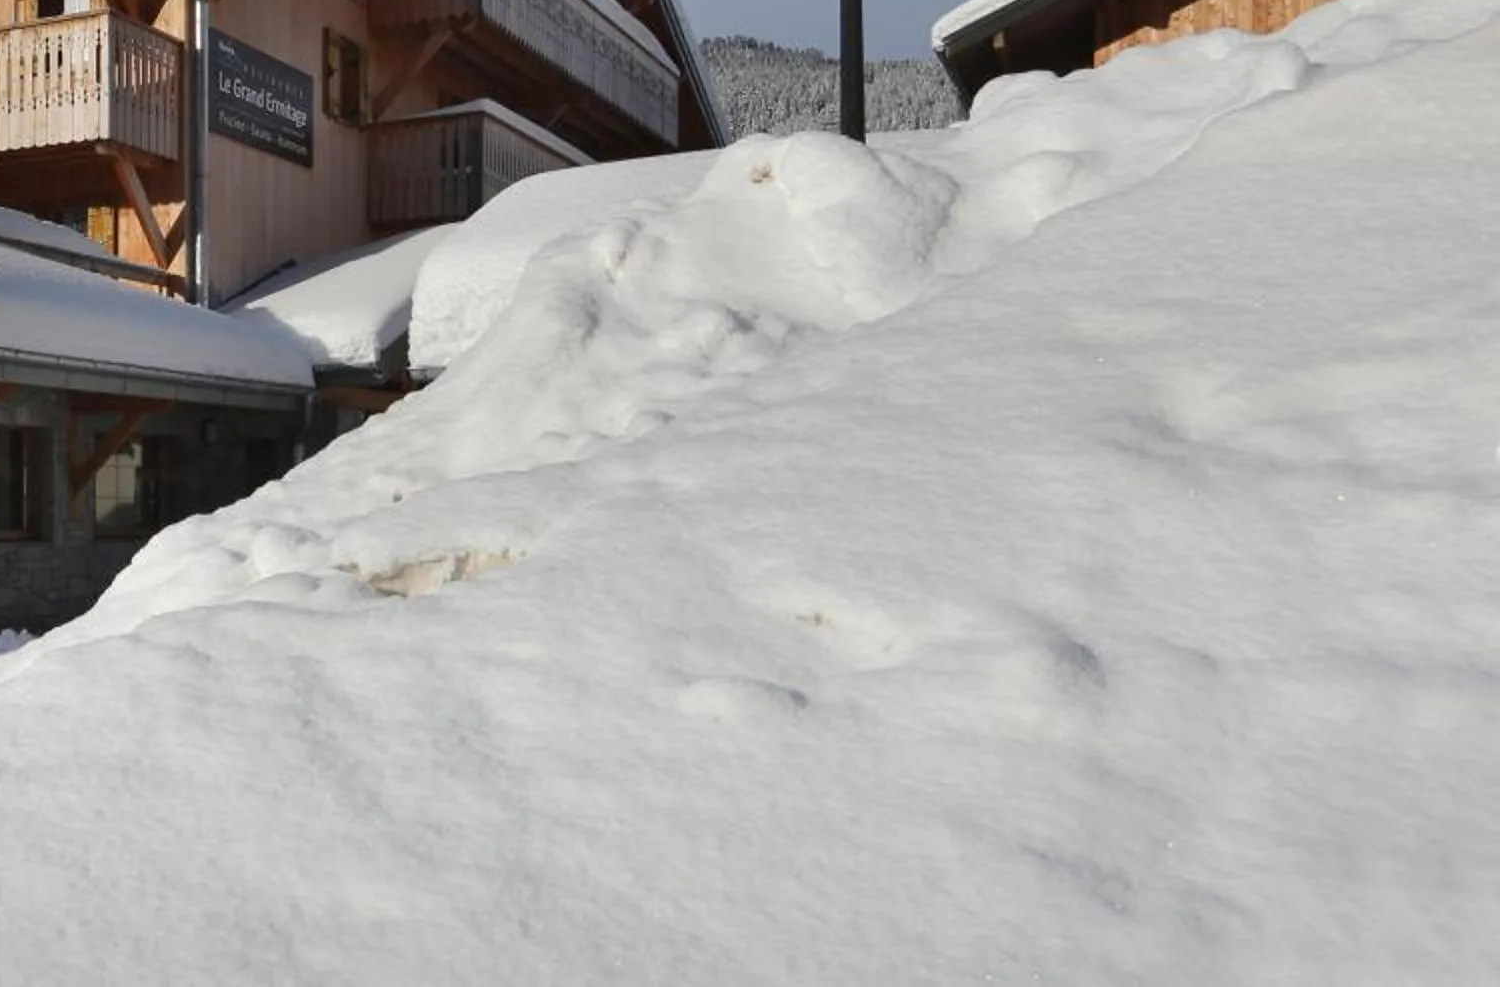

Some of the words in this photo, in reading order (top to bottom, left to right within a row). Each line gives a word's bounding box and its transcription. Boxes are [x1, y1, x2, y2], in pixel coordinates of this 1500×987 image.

[219, 70, 231, 94] Le
[233, 78, 264, 108] Grand
[265, 92, 307, 128] Ermitage
